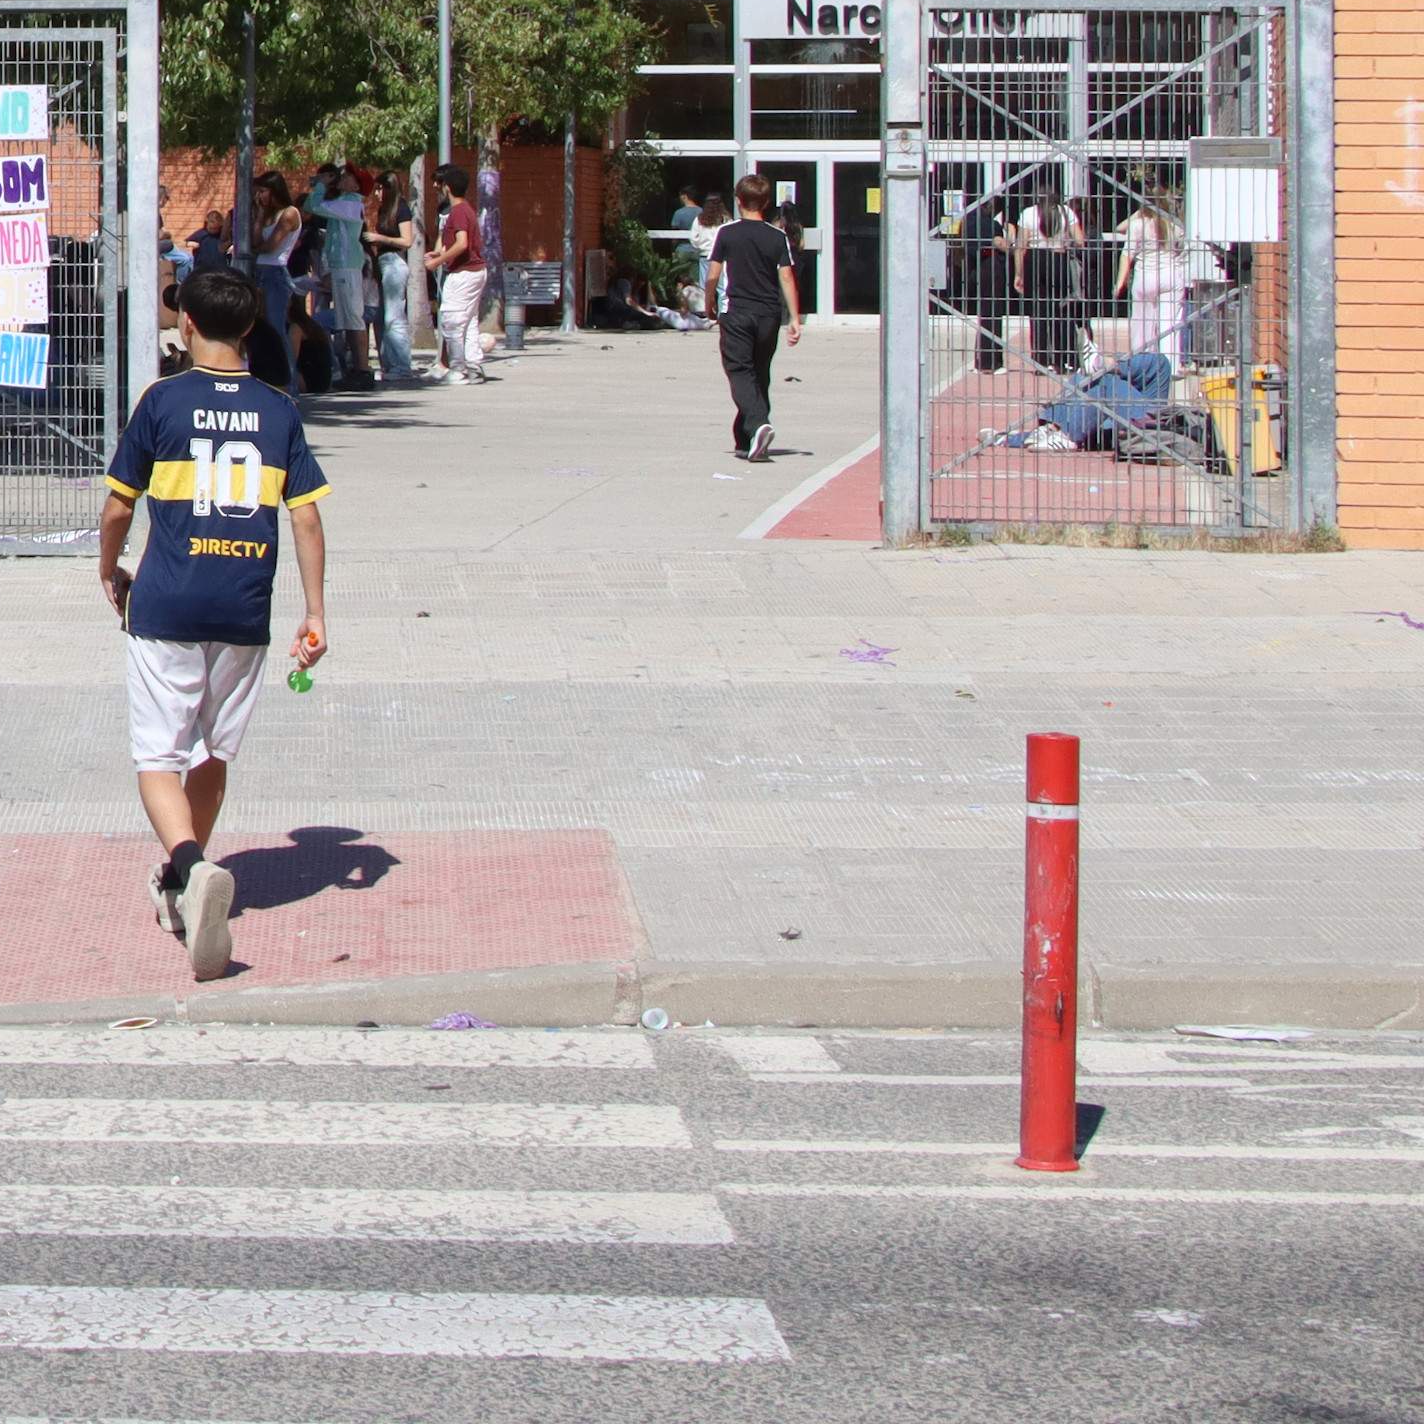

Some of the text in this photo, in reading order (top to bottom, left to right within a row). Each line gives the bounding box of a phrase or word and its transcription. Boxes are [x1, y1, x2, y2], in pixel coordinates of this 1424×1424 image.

[193, 408, 259, 432] CAVANI
[189, 437, 263, 519] 10
[189, 537, 269, 559] DIRECTV
